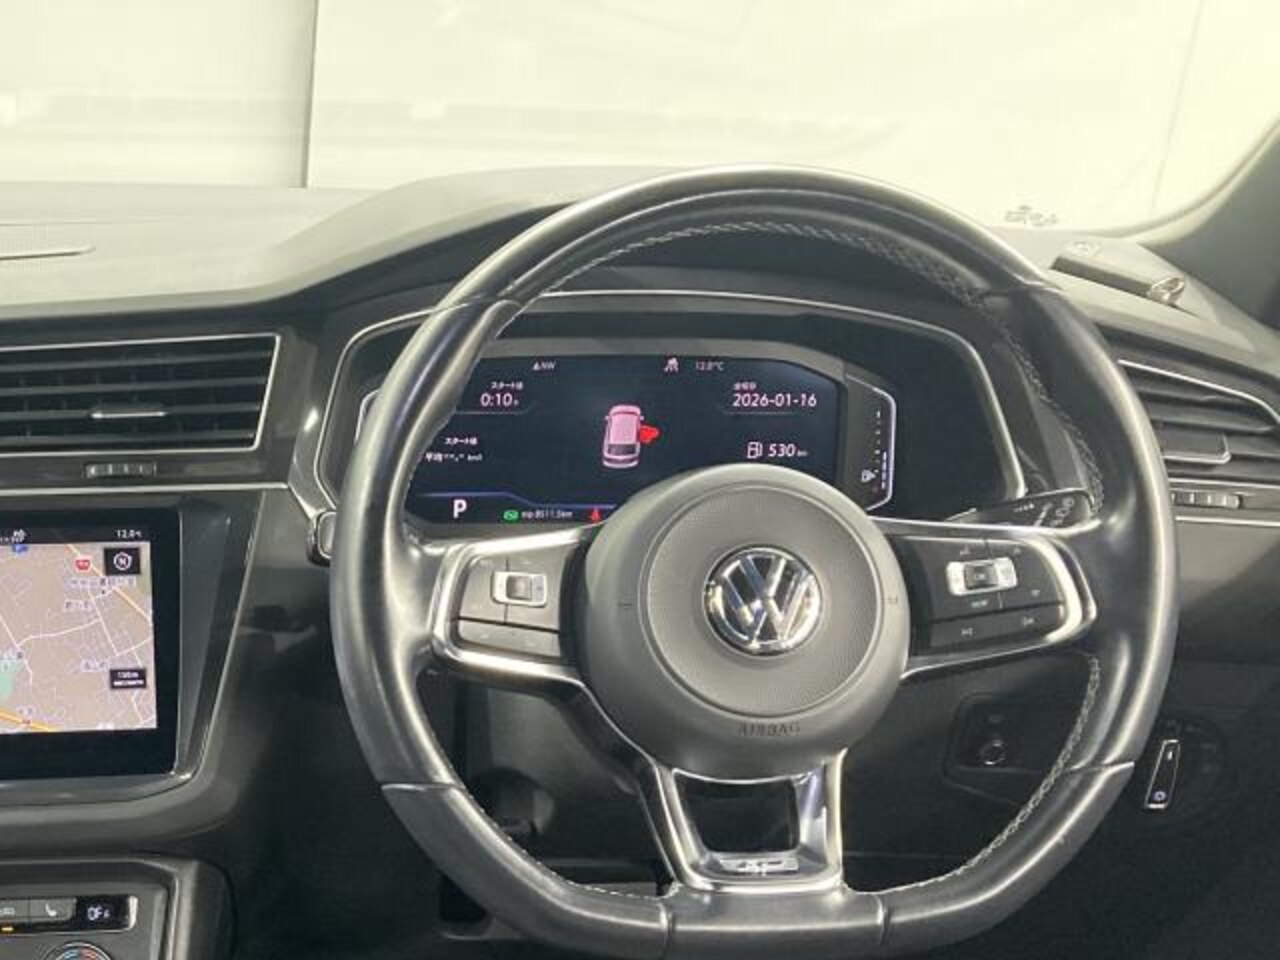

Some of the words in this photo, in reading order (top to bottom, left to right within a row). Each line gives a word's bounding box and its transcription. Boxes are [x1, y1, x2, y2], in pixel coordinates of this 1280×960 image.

[480, 393, 513, 407] 0:10
[732, 393, 818, 407] 2026-01-16
[768, 443, 796, 457] 530
[452, 498, 467, 519] P
